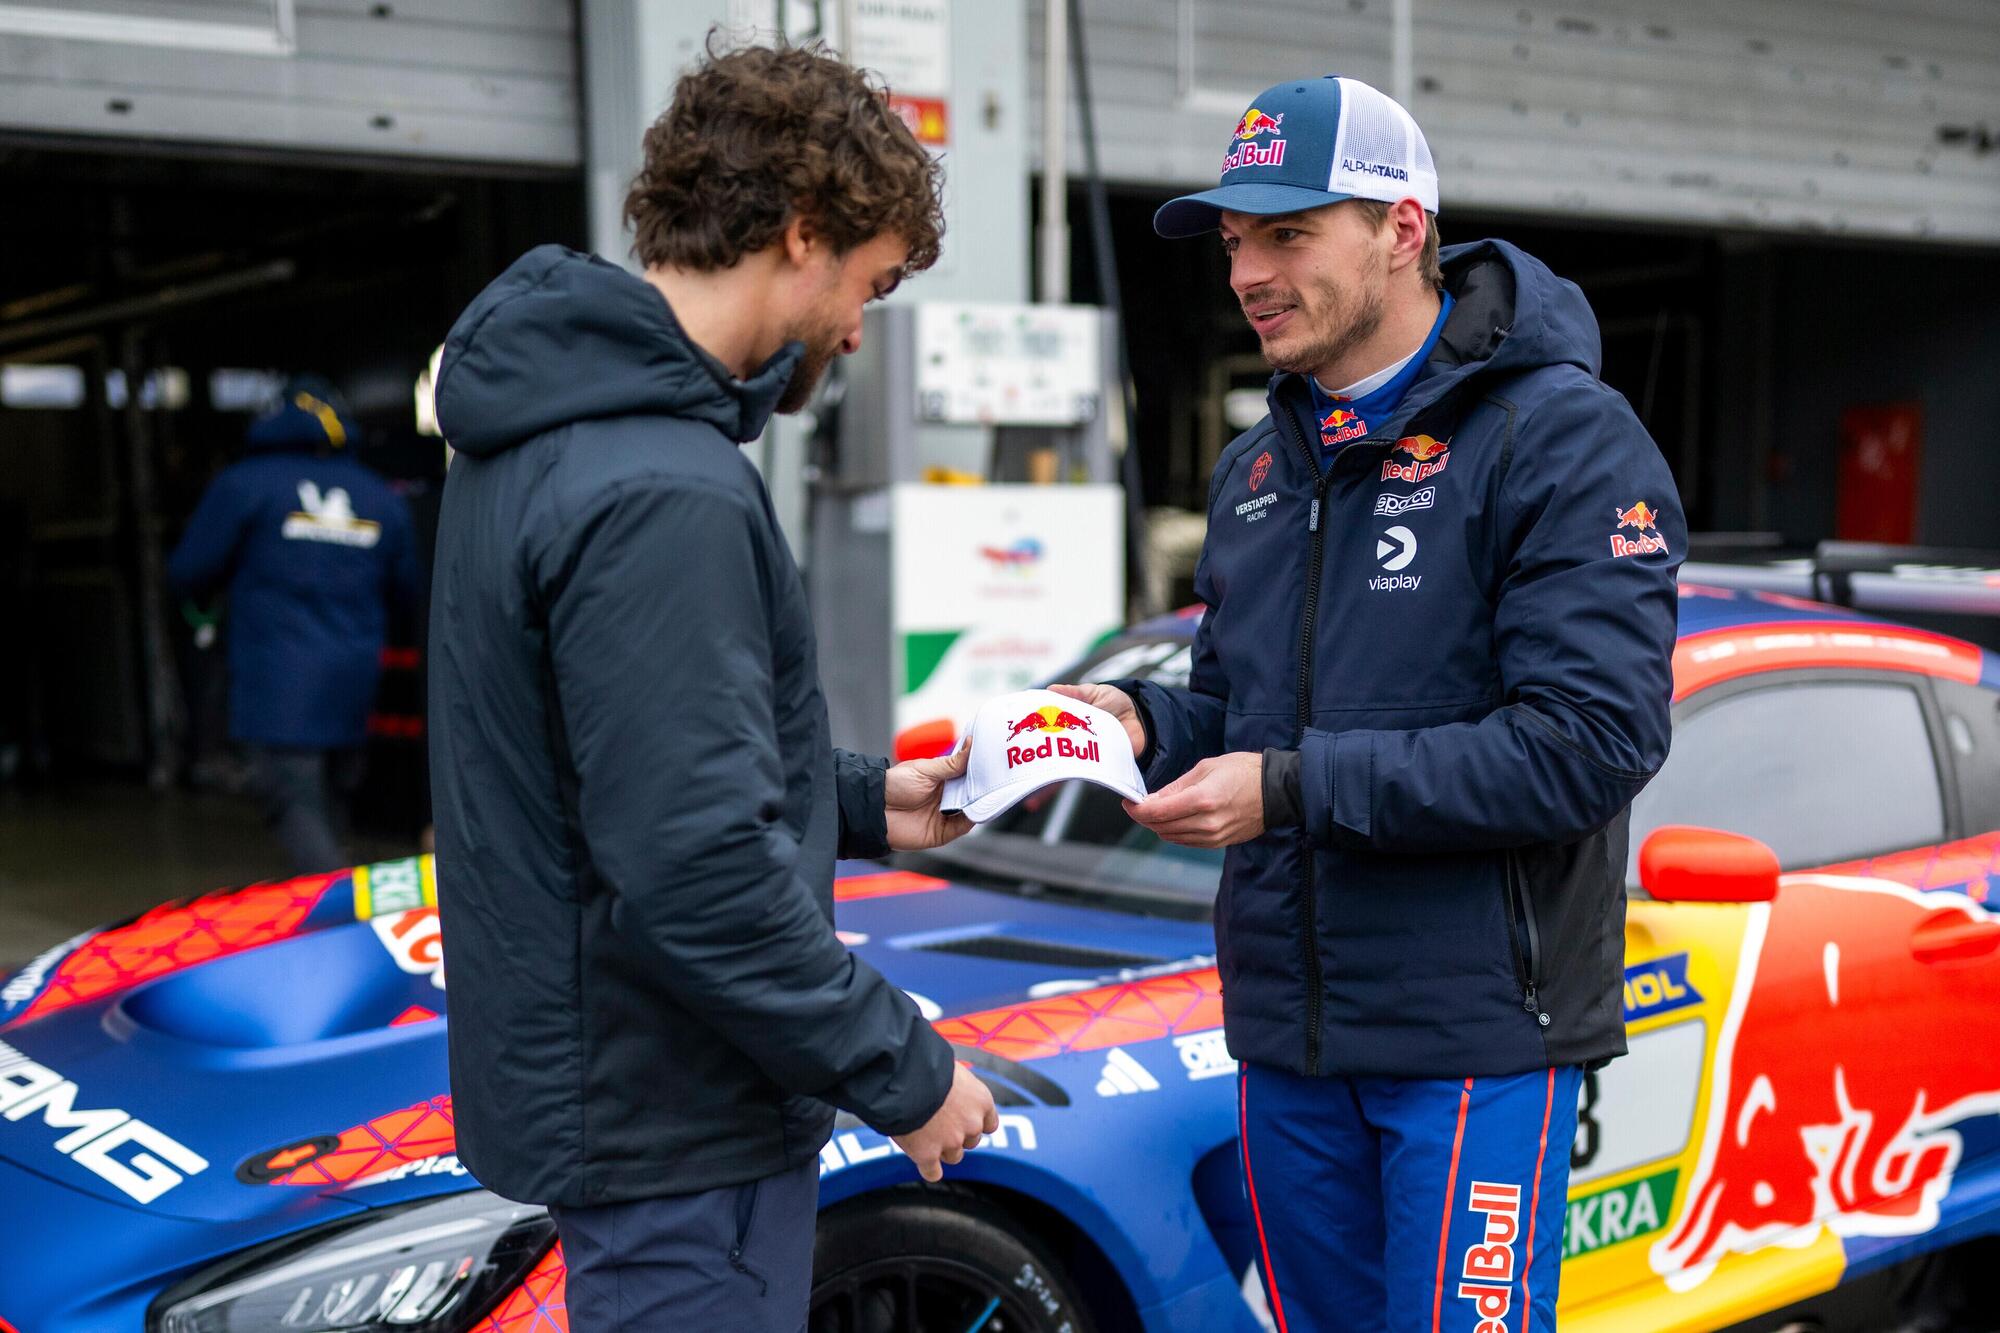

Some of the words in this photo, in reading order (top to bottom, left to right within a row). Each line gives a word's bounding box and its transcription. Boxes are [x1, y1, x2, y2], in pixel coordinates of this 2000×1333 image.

[1241, 140, 1287, 167] Bull
[1342, 159, 1408, 182] ALPHATAURI
[1321, 428, 1346, 446] Red
[1341, 420, 1368, 441] Bull
[1381, 460, 1419, 483] Red
[1416, 452, 1450, 483] Bull
[1236, 492, 1278, 516] VERSTAPPEN
[1375, 488, 1434, 514] spaco
[1246, 509, 1267, 523] RACING
[1369, 574, 1421, 592] viaplay
[1007, 737, 1052, 769] Red
[1057, 737, 1100, 763] Bull
[0, 1061, 209, 1204] AMG
[1457, 1180, 1522, 1282] Bull
[1561, 1179, 1659, 1257] KRA
